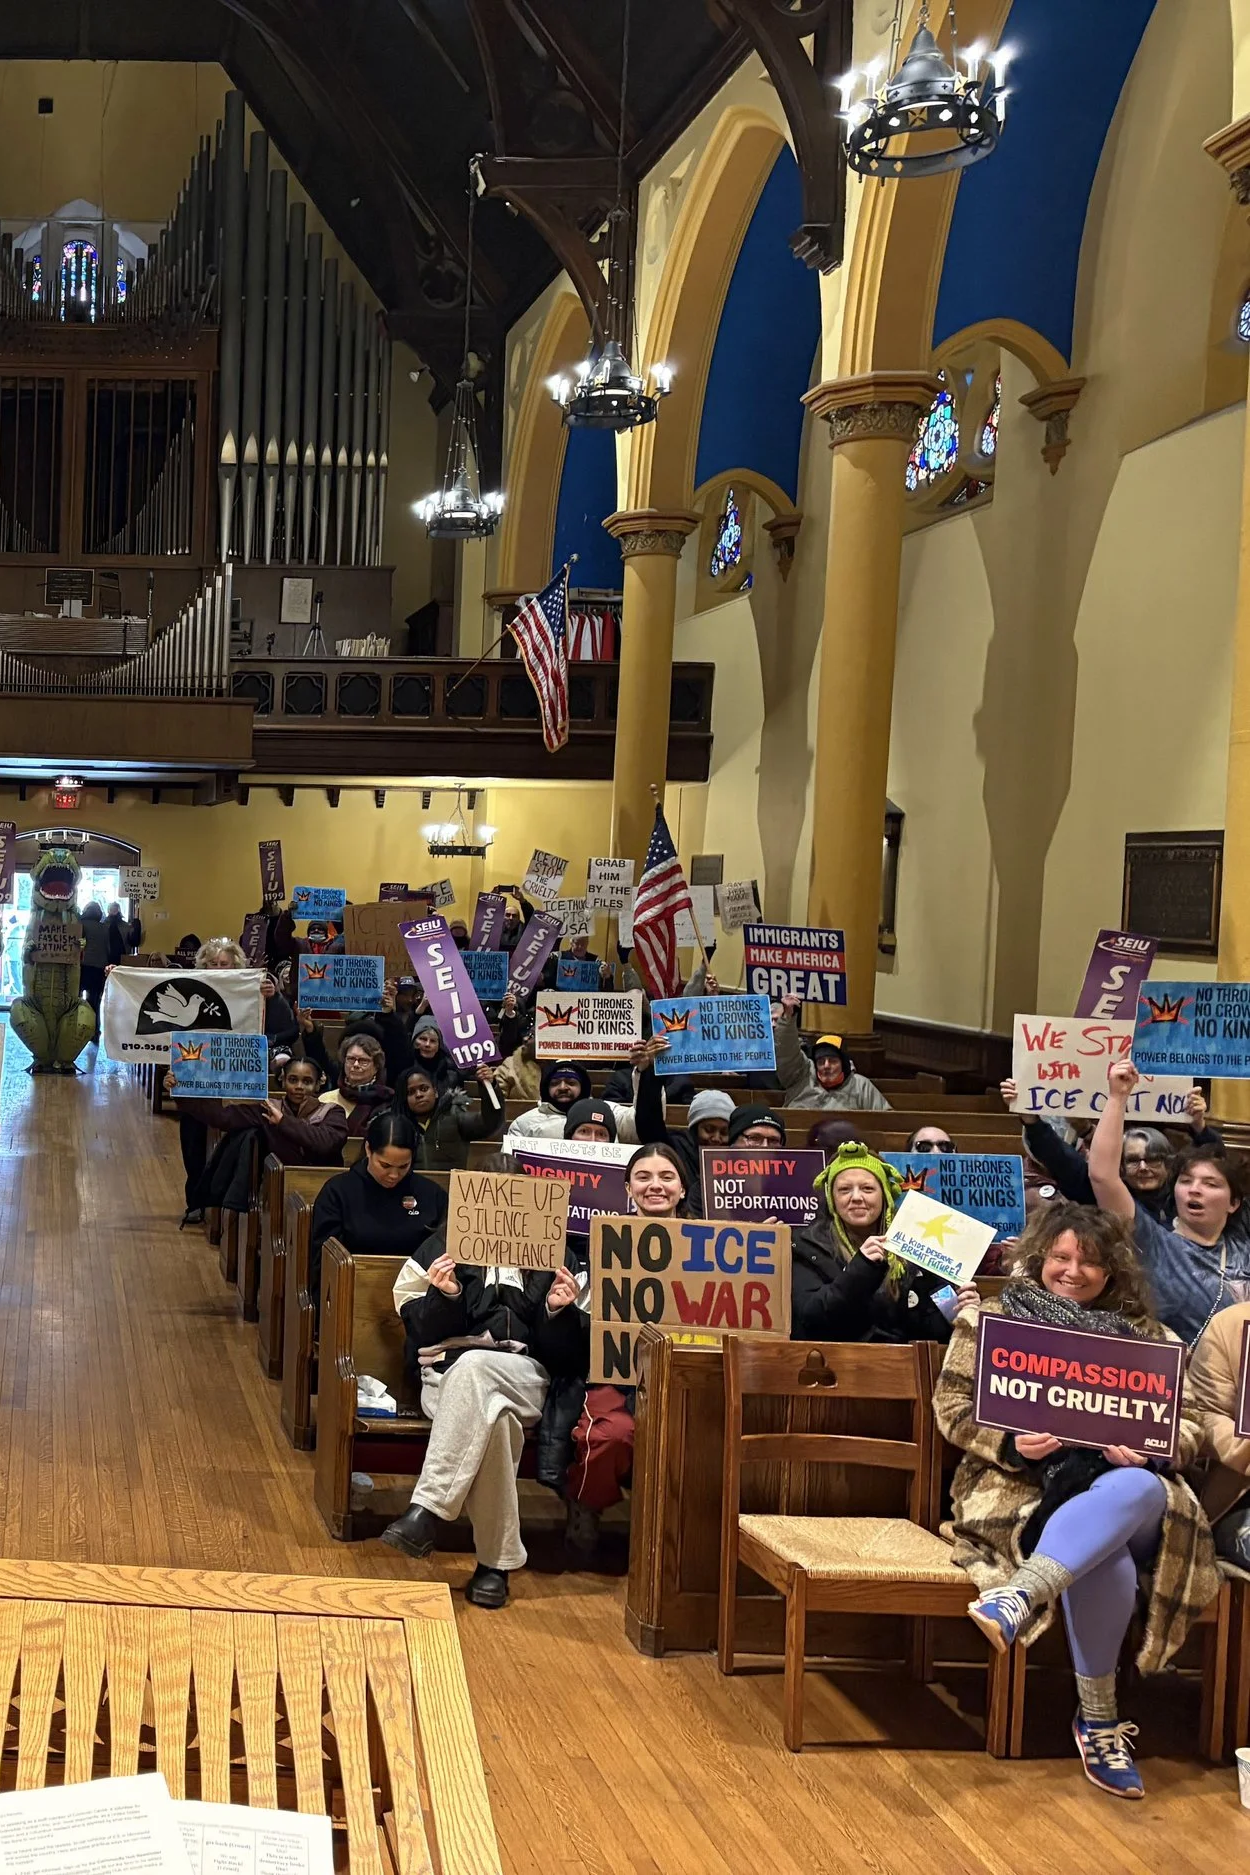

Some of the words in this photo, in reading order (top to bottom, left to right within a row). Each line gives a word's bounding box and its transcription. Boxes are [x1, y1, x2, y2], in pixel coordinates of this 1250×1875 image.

[533, 849, 549, 862] ICE
[551, 856, 569, 870] OUT
[595, 859, 625, 867] GRAB
[267, 851, 278, 891] SEIU
[532, 863, 562, 879] STOP
[599, 872, 620, 880] HIM
[535, 875, 548, 885] THE
[265, 892, 284, 900] 1199
[523, 880, 558, 899] CRUELTY
[588, 885, 603, 893] BY
[609, 886, 630, 895] THE
[544, 900, 566, 912] ICE
[594, 898, 623, 908] FILES
[39, 924, 67, 933] MAKE
[415, 919, 441, 932] SEIU
[38, 935, 76, 943] FASCISM
[748, 928, 839, 949] IMMIGRANTS
[1115, 936, 1150, 951] SEIU
[750, 948, 783, 965] MAKE
[786, 951, 840, 969] AMERICA
[427, 943, 477, 1039] SEIU
[752, 967, 841, 1003] GREAT
[578, 998, 589, 1008] NO
[592, 999, 634, 1009] THRONES.
[699, 1001, 713, 1012] NO
[715, 1000, 763, 1012] THRONES.
[578, 1021, 593, 1034] NO
[598, 1021, 637, 1035] KINGS.
[702, 1025, 720, 1040] NO
[725, 1024, 769, 1039] KINGS.
[1022, 1023, 1067, 1051] WE
[453, 1040, 496, 1064] 1199
[658, 1055, 683, 1064] POWER
[684, 1053, 717, 1063] BELONGS
[730, 1052, 742, 1060] THE
[745, 1052, 772, 1060] PEOPLE
[211, 1058, 225, 1071] NO
[229, 1059, 265, 1073] KINGS.
[1025, 1087, 1084, 1111] ICE
[550, 1142, 596, 1156] FACTS
[601, 1147, 622, 1158] BE
[712, 1160, 796, 1175] DIGNITY
[939, 1160, 956, 1172] NO
[959, 1160, 1014, 1174] THRONES.
[458, 1175, 524, 1208] WAKE
[534, 1182, 565, 1212] UP
[714, 1179, 746, 1194] NOT
[941, 1189, 963, 1206] NO
[969, 1189, 1021, 1207] KINGS.
[456, 1206, 530, 1238] SILENCE
[543, 1214, 562, 1240] IS
[601, 1223, 672, 1272] NO
[681, 1224, 776, 1274] ICE
[893, 1231, 906, 1242] ALL
[909, 1237, 925, 1250] KIDS
[459, 1237, 556, 1269] COMPLIANCE
[901, 1243, 929, 1263] BRIGHT
[927, 1258, 956, 1276] FUTURE
[601, 1276, 665, 1323] NO
[671, 1280, 772, 1329] WAR
[991, 1347, 1172, 1400] COMPASSION,
[990, 1374, 1042, 1403] NOT
[1048, 1384, 1170, 1424] CRUELTY.
[1144, 1438, 1167, 1448] ACLU
